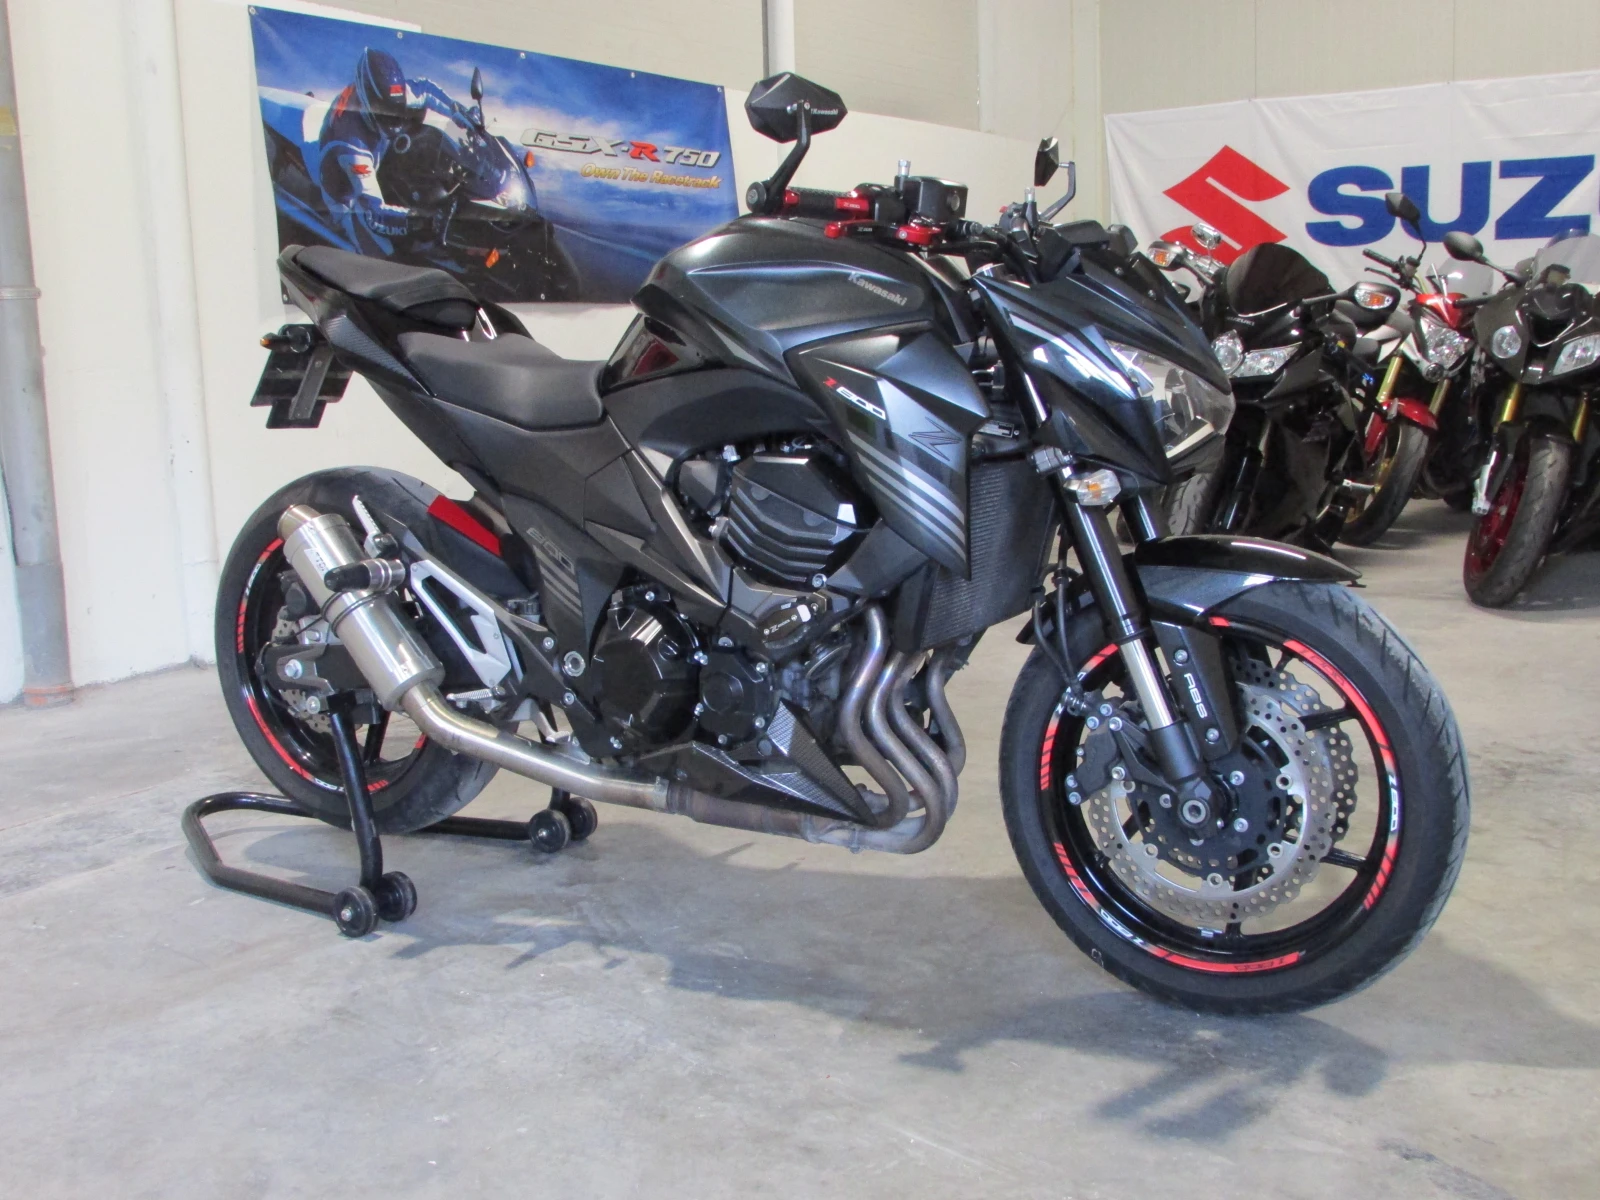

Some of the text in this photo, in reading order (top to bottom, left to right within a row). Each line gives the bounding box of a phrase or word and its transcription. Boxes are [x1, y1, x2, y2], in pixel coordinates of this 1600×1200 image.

[580, 163, 722, 189] Own The Racetrack
[663, 145, 721, 168] 750
[1305, 154, 1600, 247] SUZ
[848, 271, 908, 306] Kawasaki
[526, 527, 575, 575] 800
[1184, 672, 1208, 719] ABS
